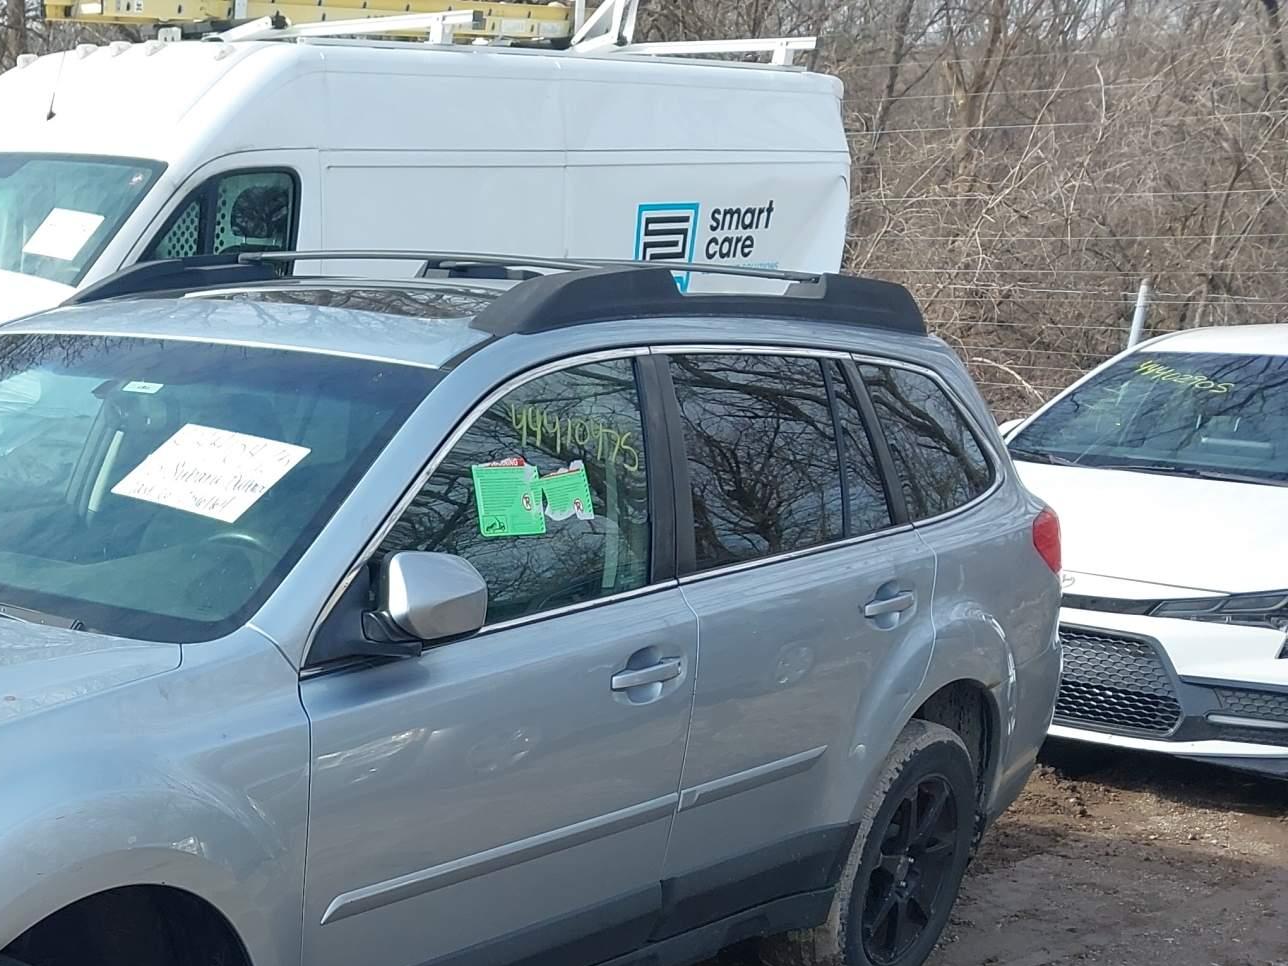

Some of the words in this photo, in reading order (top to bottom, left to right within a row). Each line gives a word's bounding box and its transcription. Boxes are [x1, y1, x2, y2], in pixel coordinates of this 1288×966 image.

[709, 199, 774, 232] smart
[705, 234, 755, 260] care
[511, 403, 639, 472] 44410475
